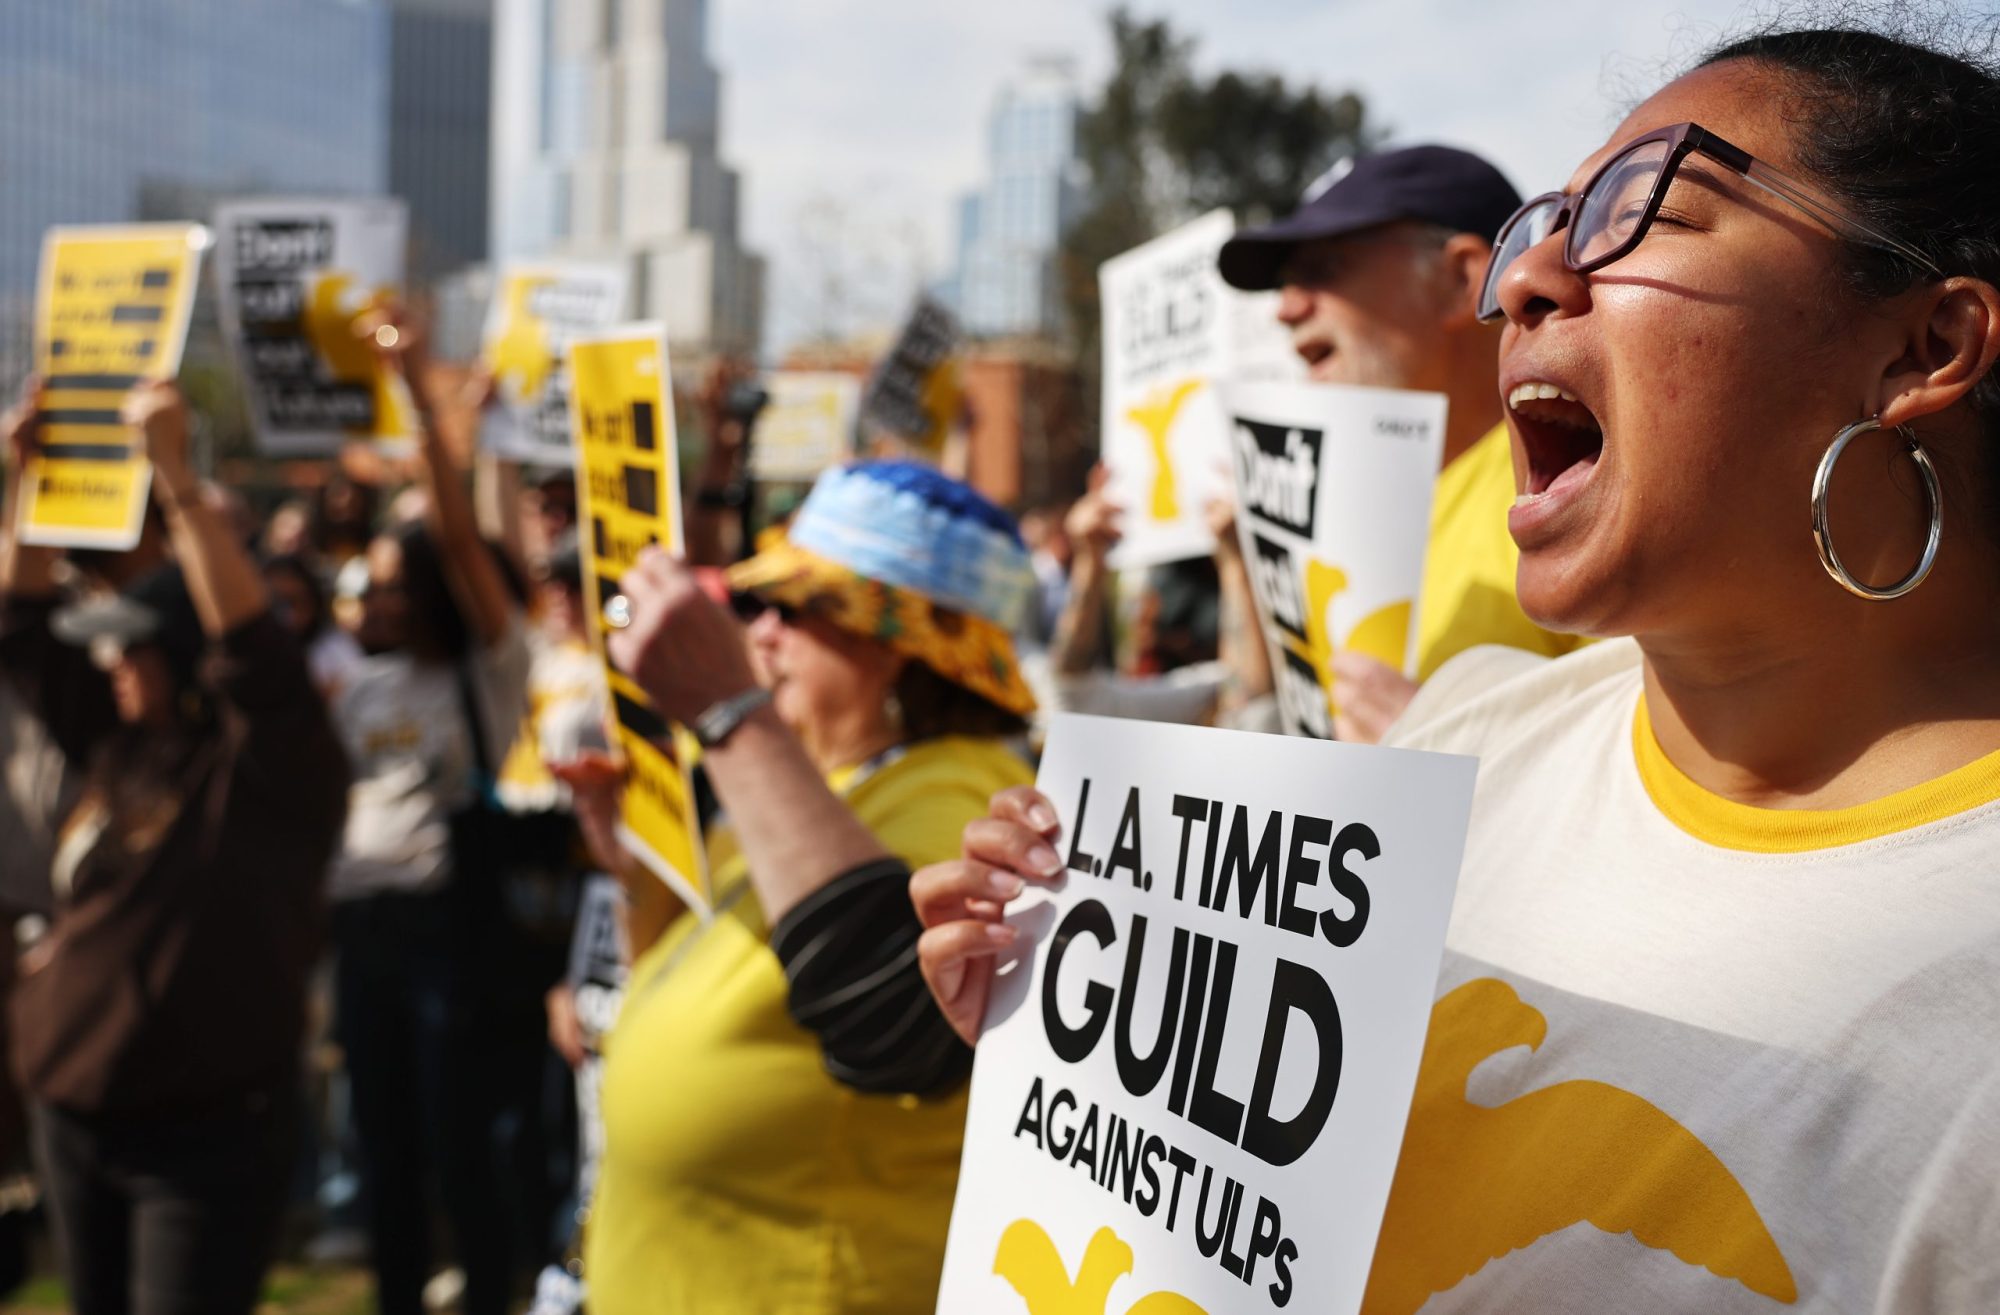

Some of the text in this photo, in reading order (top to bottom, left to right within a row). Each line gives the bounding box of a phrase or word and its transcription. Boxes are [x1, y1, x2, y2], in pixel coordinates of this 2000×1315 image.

[1234, 424, 1316, 528] Don't
[1067, 778, 1381, 948] L.A. TIMES
[1041, 898, 1343, 1167] GUILD
[1014, 1077, 1299, 1308] AGAINST ULPs
